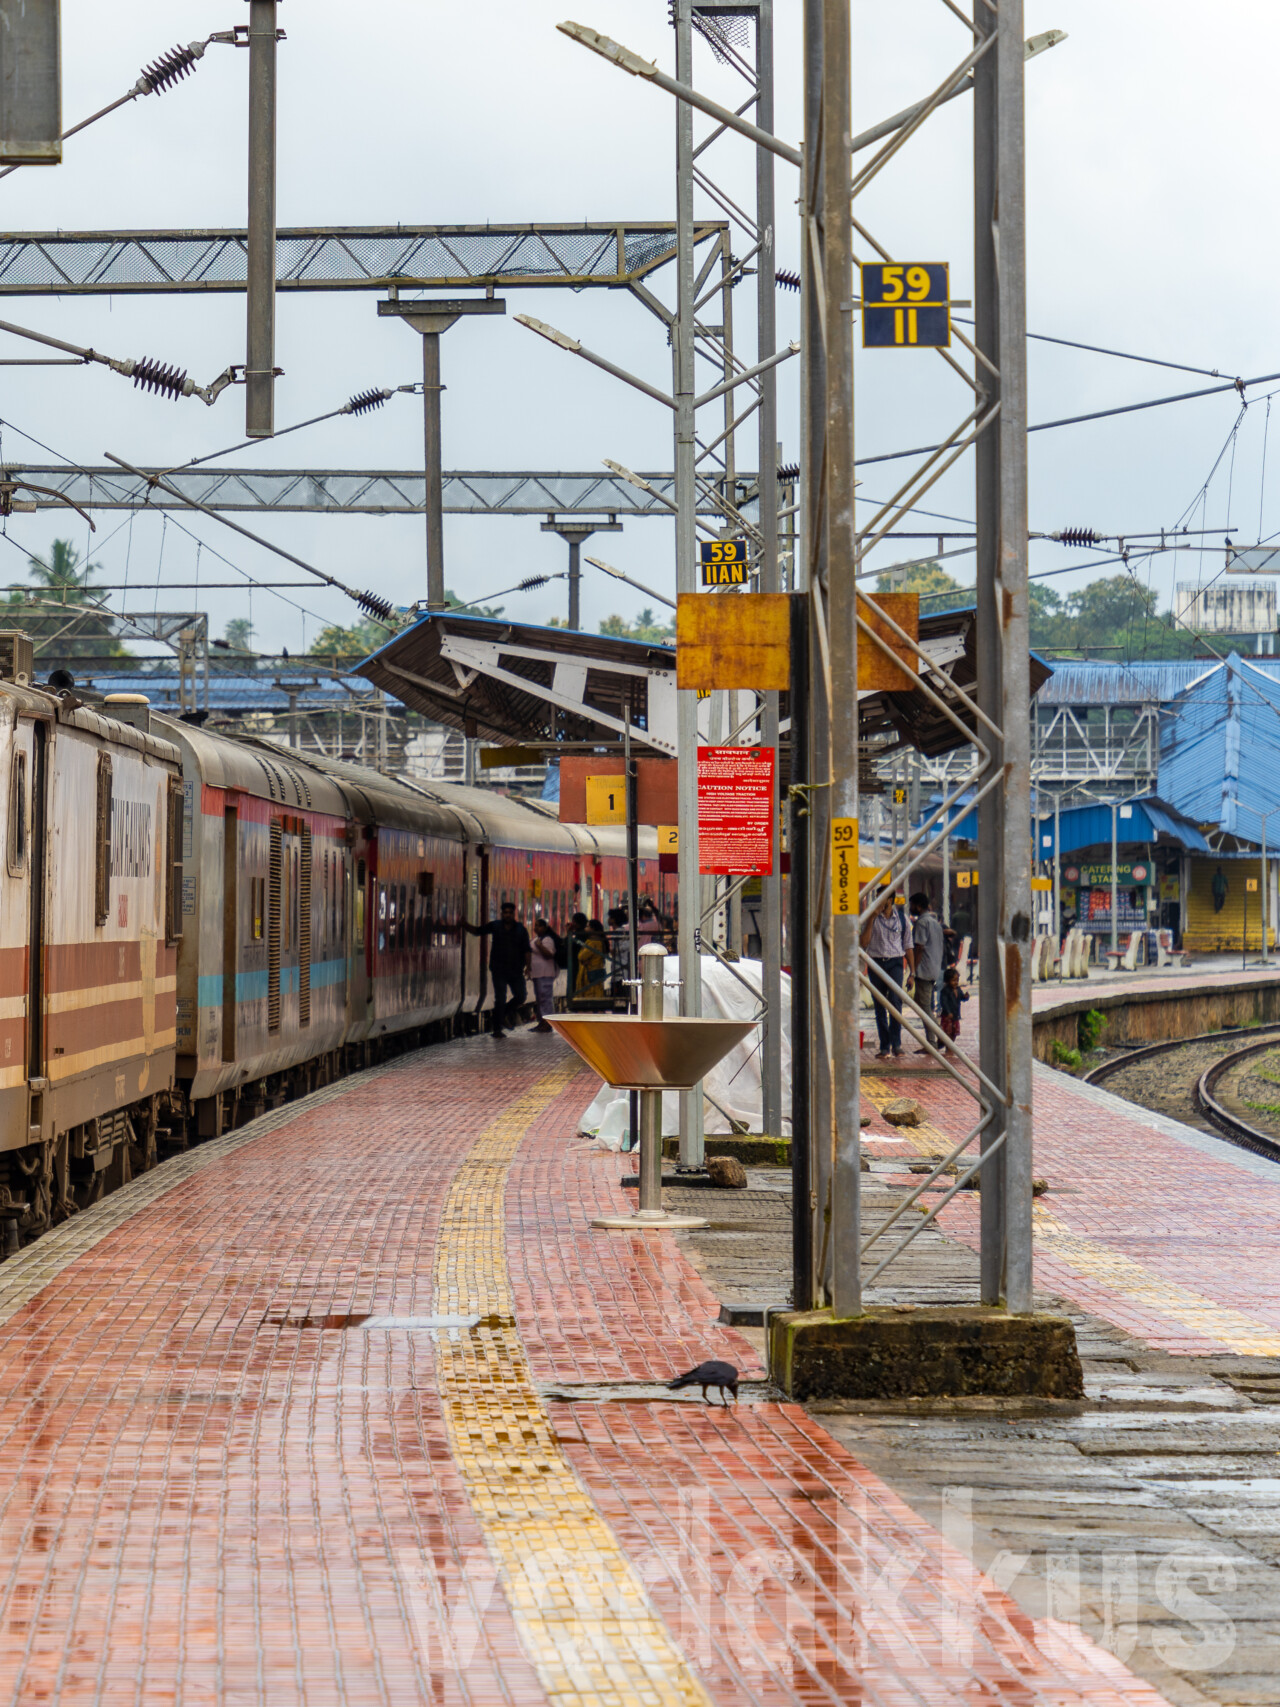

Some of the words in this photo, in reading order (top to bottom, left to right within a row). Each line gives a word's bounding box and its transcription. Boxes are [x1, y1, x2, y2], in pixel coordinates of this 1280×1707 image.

[882, 266, 931, 301] 59
[711, 543, 737, 562] 59
[608, 794, 615, 810] 1
[669, 832, 678, 843] 2
[834, 825, 853, 841] 59
[1081, 865, 1131, 873] CATERNG
